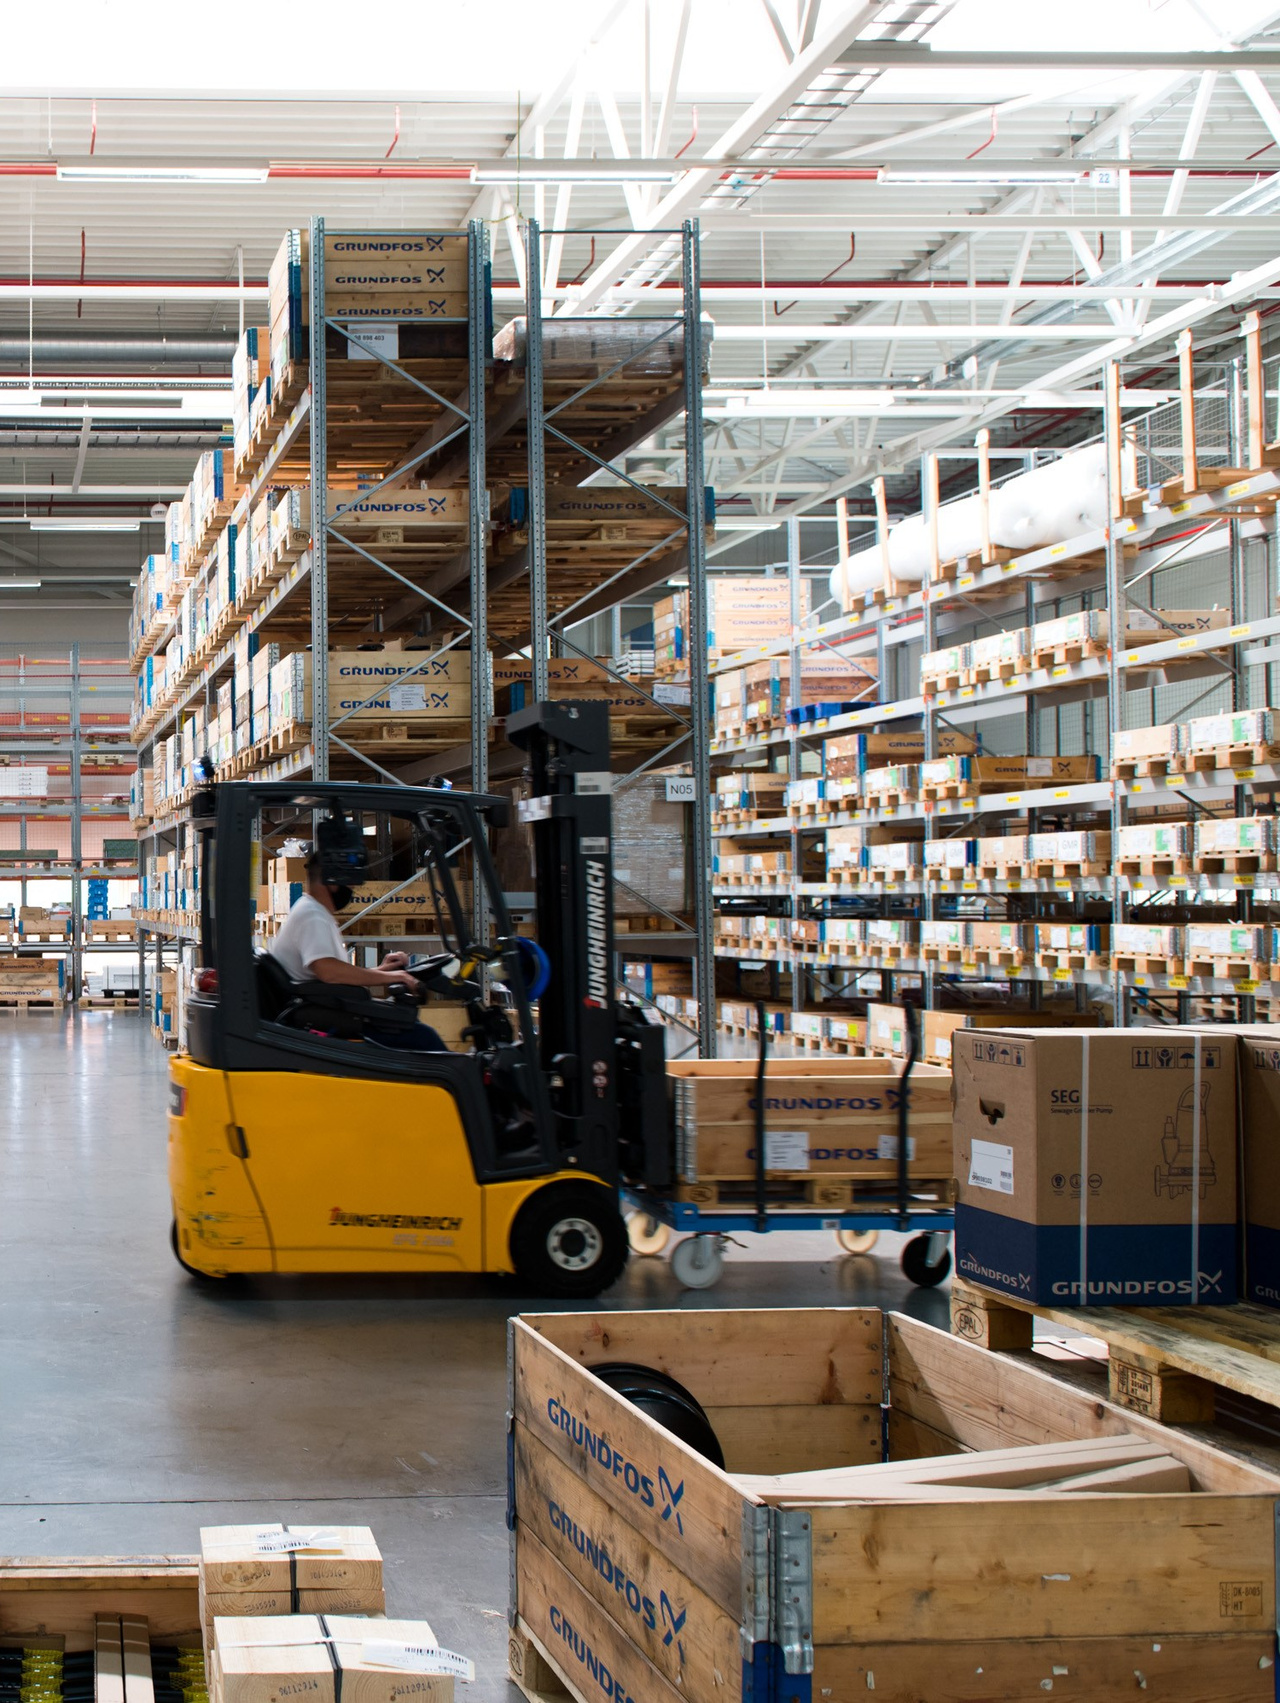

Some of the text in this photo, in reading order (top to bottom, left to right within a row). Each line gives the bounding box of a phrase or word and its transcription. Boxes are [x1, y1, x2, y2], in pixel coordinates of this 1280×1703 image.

[1098, 173, 1110, 184] 22
[333, 242, 424, 251] GRUNDFOS
[335, 276, 422, 284] GRUNDFOS
[336, 503, 426, 512] GRUNDFOS
[559, 502, 647, 510] GRUNDFOS
[671, 784, 693, 794] N05
[351, 896, 426, 904] RUNDFOS
[586, 860, 608, 1009] JUNGHEINRICH
[1051, 1089, 1080, 1103] SEG
[1051, 1107, 1073, 1115] Sewage
[1096, 1107, 1113, 1115] Pump
[329, 1212, 463, 1231] JUNGHEINRICH
[960, 1259, 1018, 1288] GRUNDFOS
[1052, 1280, 1193, 1295] GRUNDFOS
[547, 1397, 654, 1508] GRUNDFOS
[548, 1500, 656, 1631] GRUNDFOS
[1233, 1601, 1243, 1611] HT
[549, 1605, 637, 1703] GRUNDF
